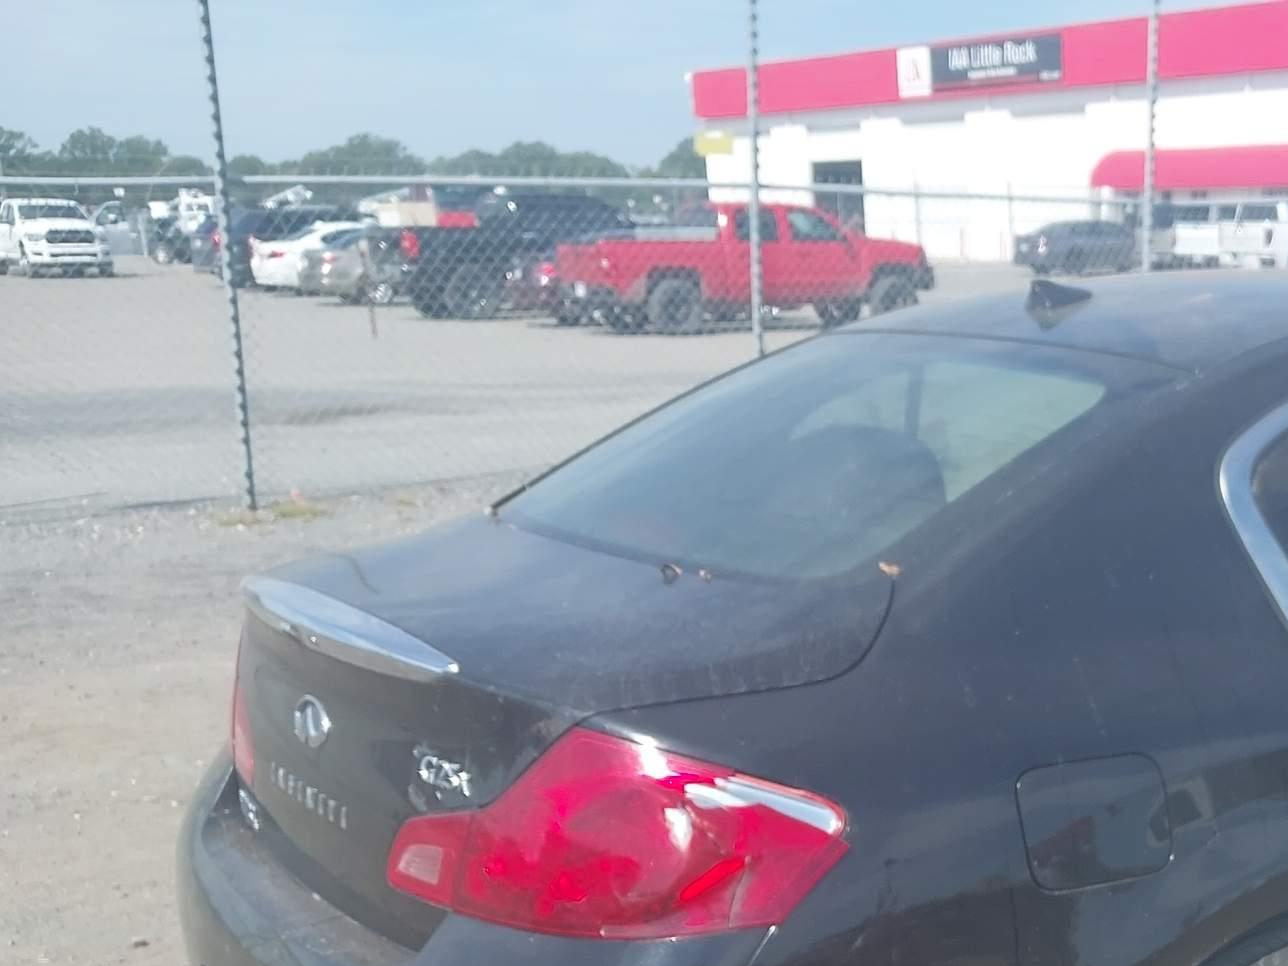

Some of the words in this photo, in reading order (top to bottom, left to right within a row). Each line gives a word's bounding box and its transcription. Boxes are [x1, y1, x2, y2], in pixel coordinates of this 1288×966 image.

[949, 47, 970, 70] IAA
[971, 44, 1003, 68] Little
[1004, 40, 1038, 65] Rock
